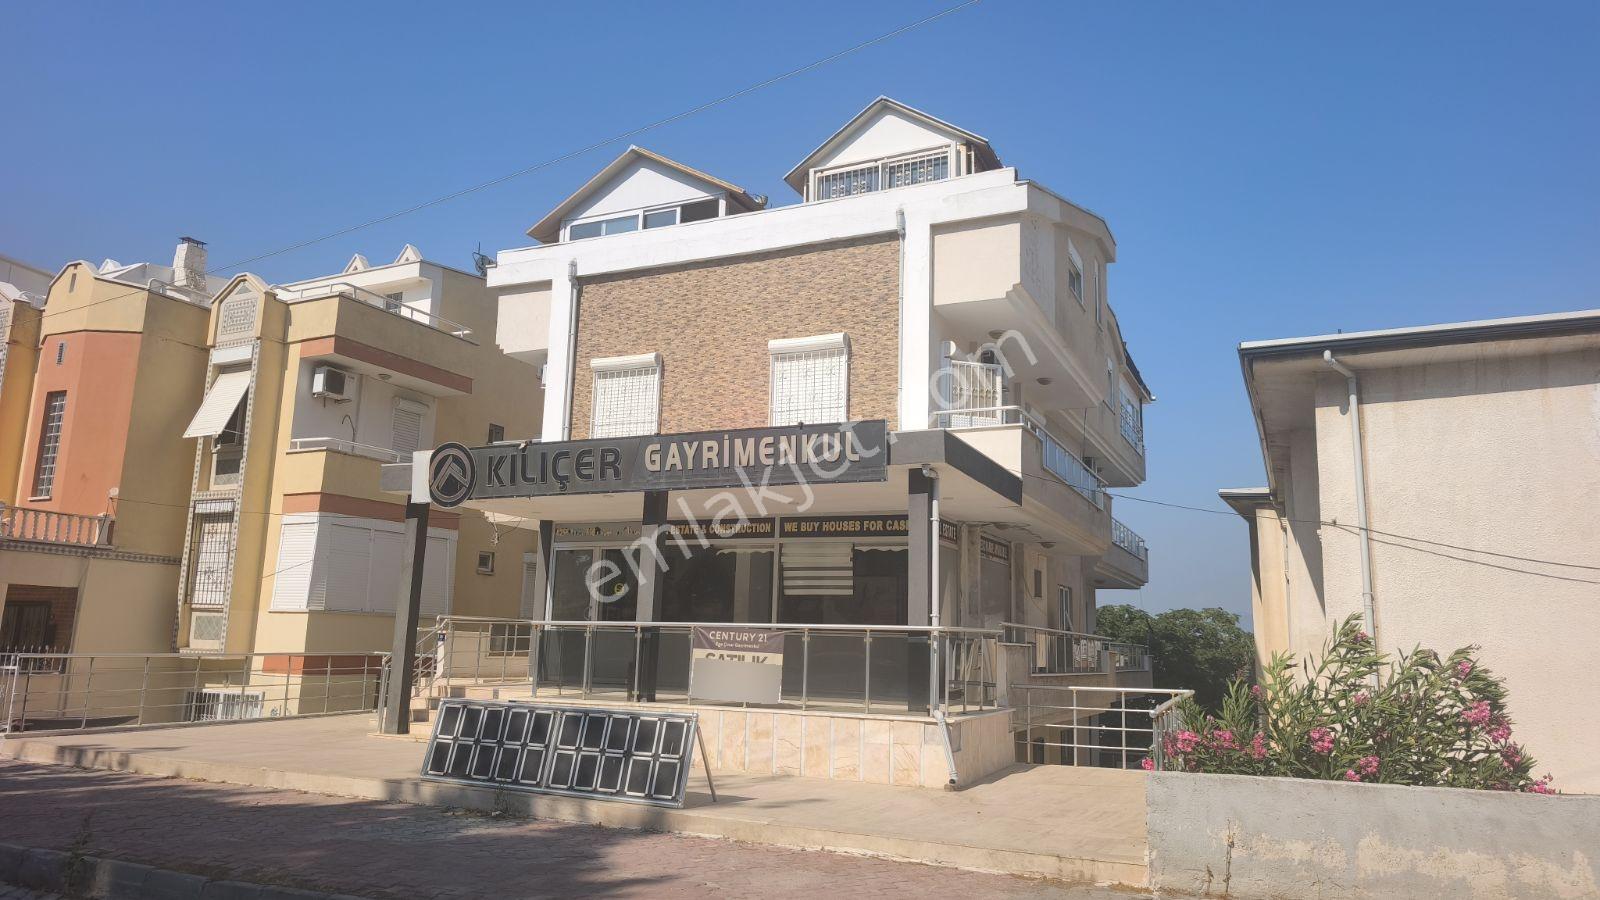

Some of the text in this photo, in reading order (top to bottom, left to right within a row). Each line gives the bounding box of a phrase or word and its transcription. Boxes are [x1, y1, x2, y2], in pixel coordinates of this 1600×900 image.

[485, 431, 862, 491] KILIÇER GAYRİMENKUL
[709, 522, 772, 535] CONSTRUCTION
[784, 521, 798, 533] WE
[801, 521, 818, 532] BUY
[823, 520, 860, 532] HOUSES
[863, 520, 884, 531] FOR
[709, 631, 767, 643] CENTURY 21
